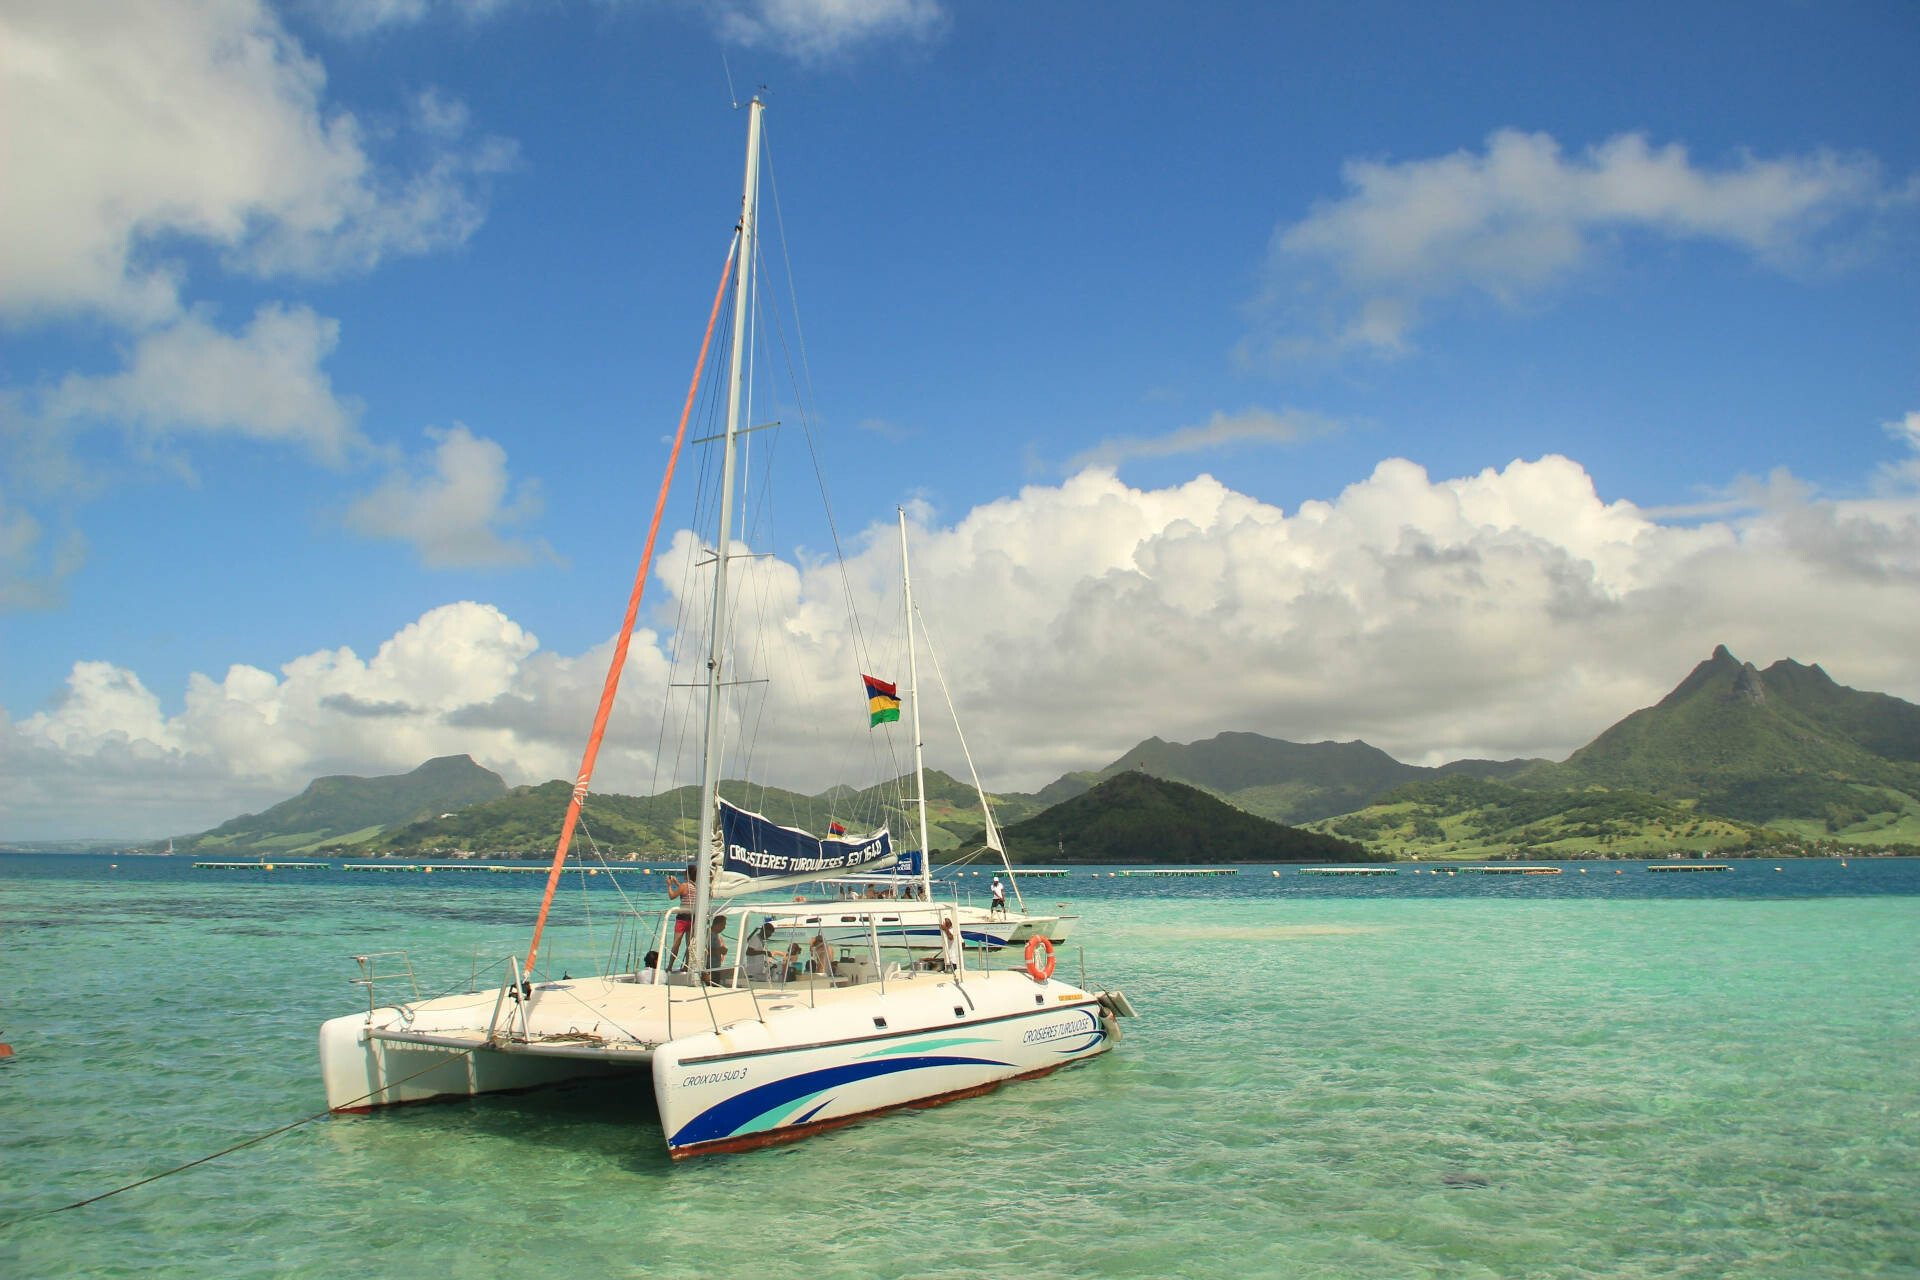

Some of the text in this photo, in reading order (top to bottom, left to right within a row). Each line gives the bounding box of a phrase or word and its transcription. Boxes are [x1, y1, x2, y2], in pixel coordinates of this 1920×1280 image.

[846, 851, 863, 867] 631
[863, 840, 882, 863] 1640
[683, 1067, 748, 1087] CROIX DU SUD 3
